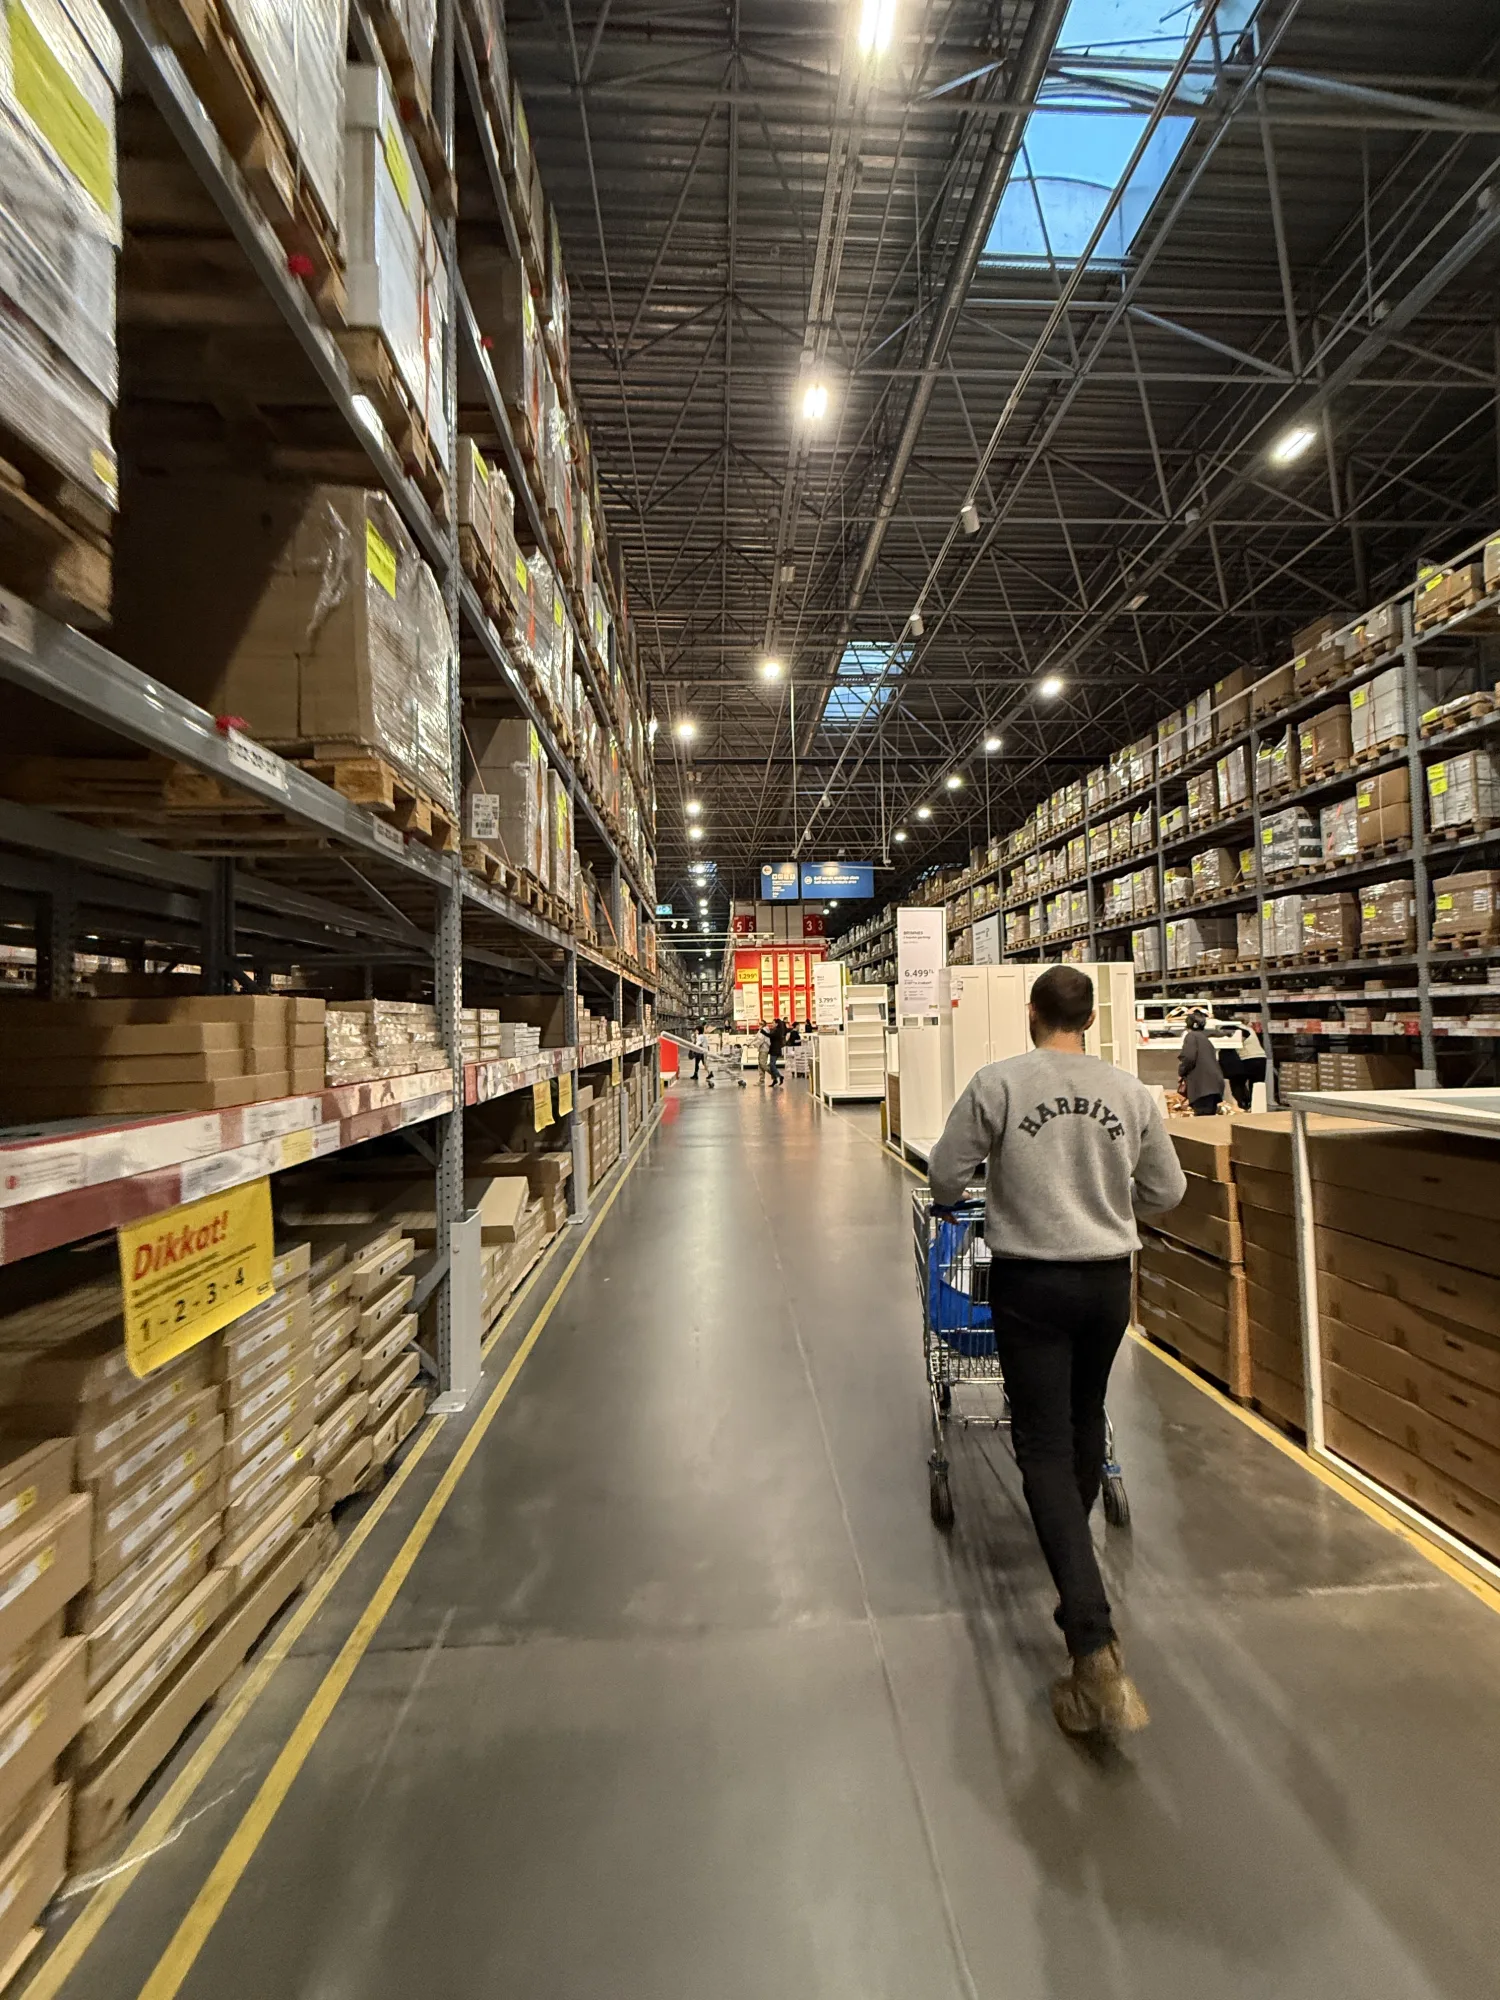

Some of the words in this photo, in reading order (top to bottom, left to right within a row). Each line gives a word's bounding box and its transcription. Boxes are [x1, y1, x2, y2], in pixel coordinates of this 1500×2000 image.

[736, 921, 743, 932] 5
[748, 921, 754, 932] 5
[806, 920, 813, 931] 3
[818, 920, 823, 931] 3
[1017, 1097, 1125, 1141] HARBİYE
[132, 1210, 229, 1282] Dikkat!
[139, 1318, 151, 1343] 1
[173, 1298, 187, 1323] 2
[205, 1282, 218, 1305] 3
[234, 1266, 246, 1286] 4
